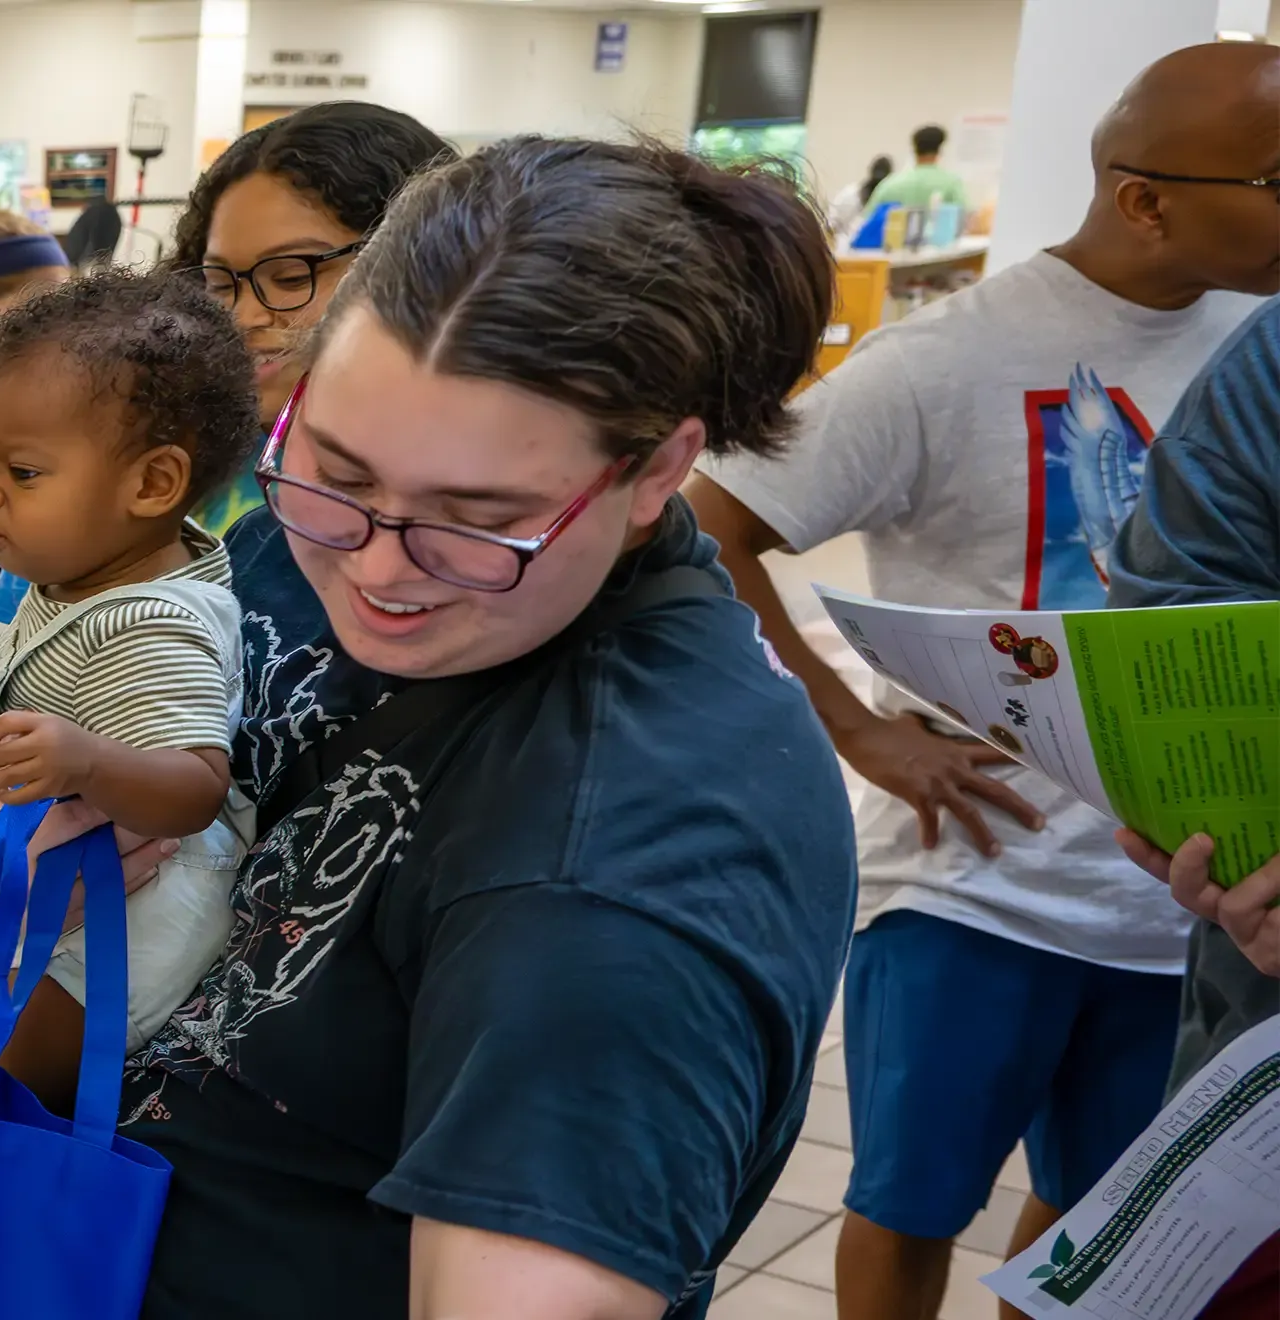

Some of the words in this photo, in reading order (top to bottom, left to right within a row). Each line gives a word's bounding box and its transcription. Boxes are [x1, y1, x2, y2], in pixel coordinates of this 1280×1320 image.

[1100, 1135, 1166, 1205] SEED
[1159, 1062, 1237, 1138] MENU
[1055, 1254, 1083, 1281] Select
[1081, 1240, 1098, 1256] the
[1062, 1270, 1083, 1289] Five
